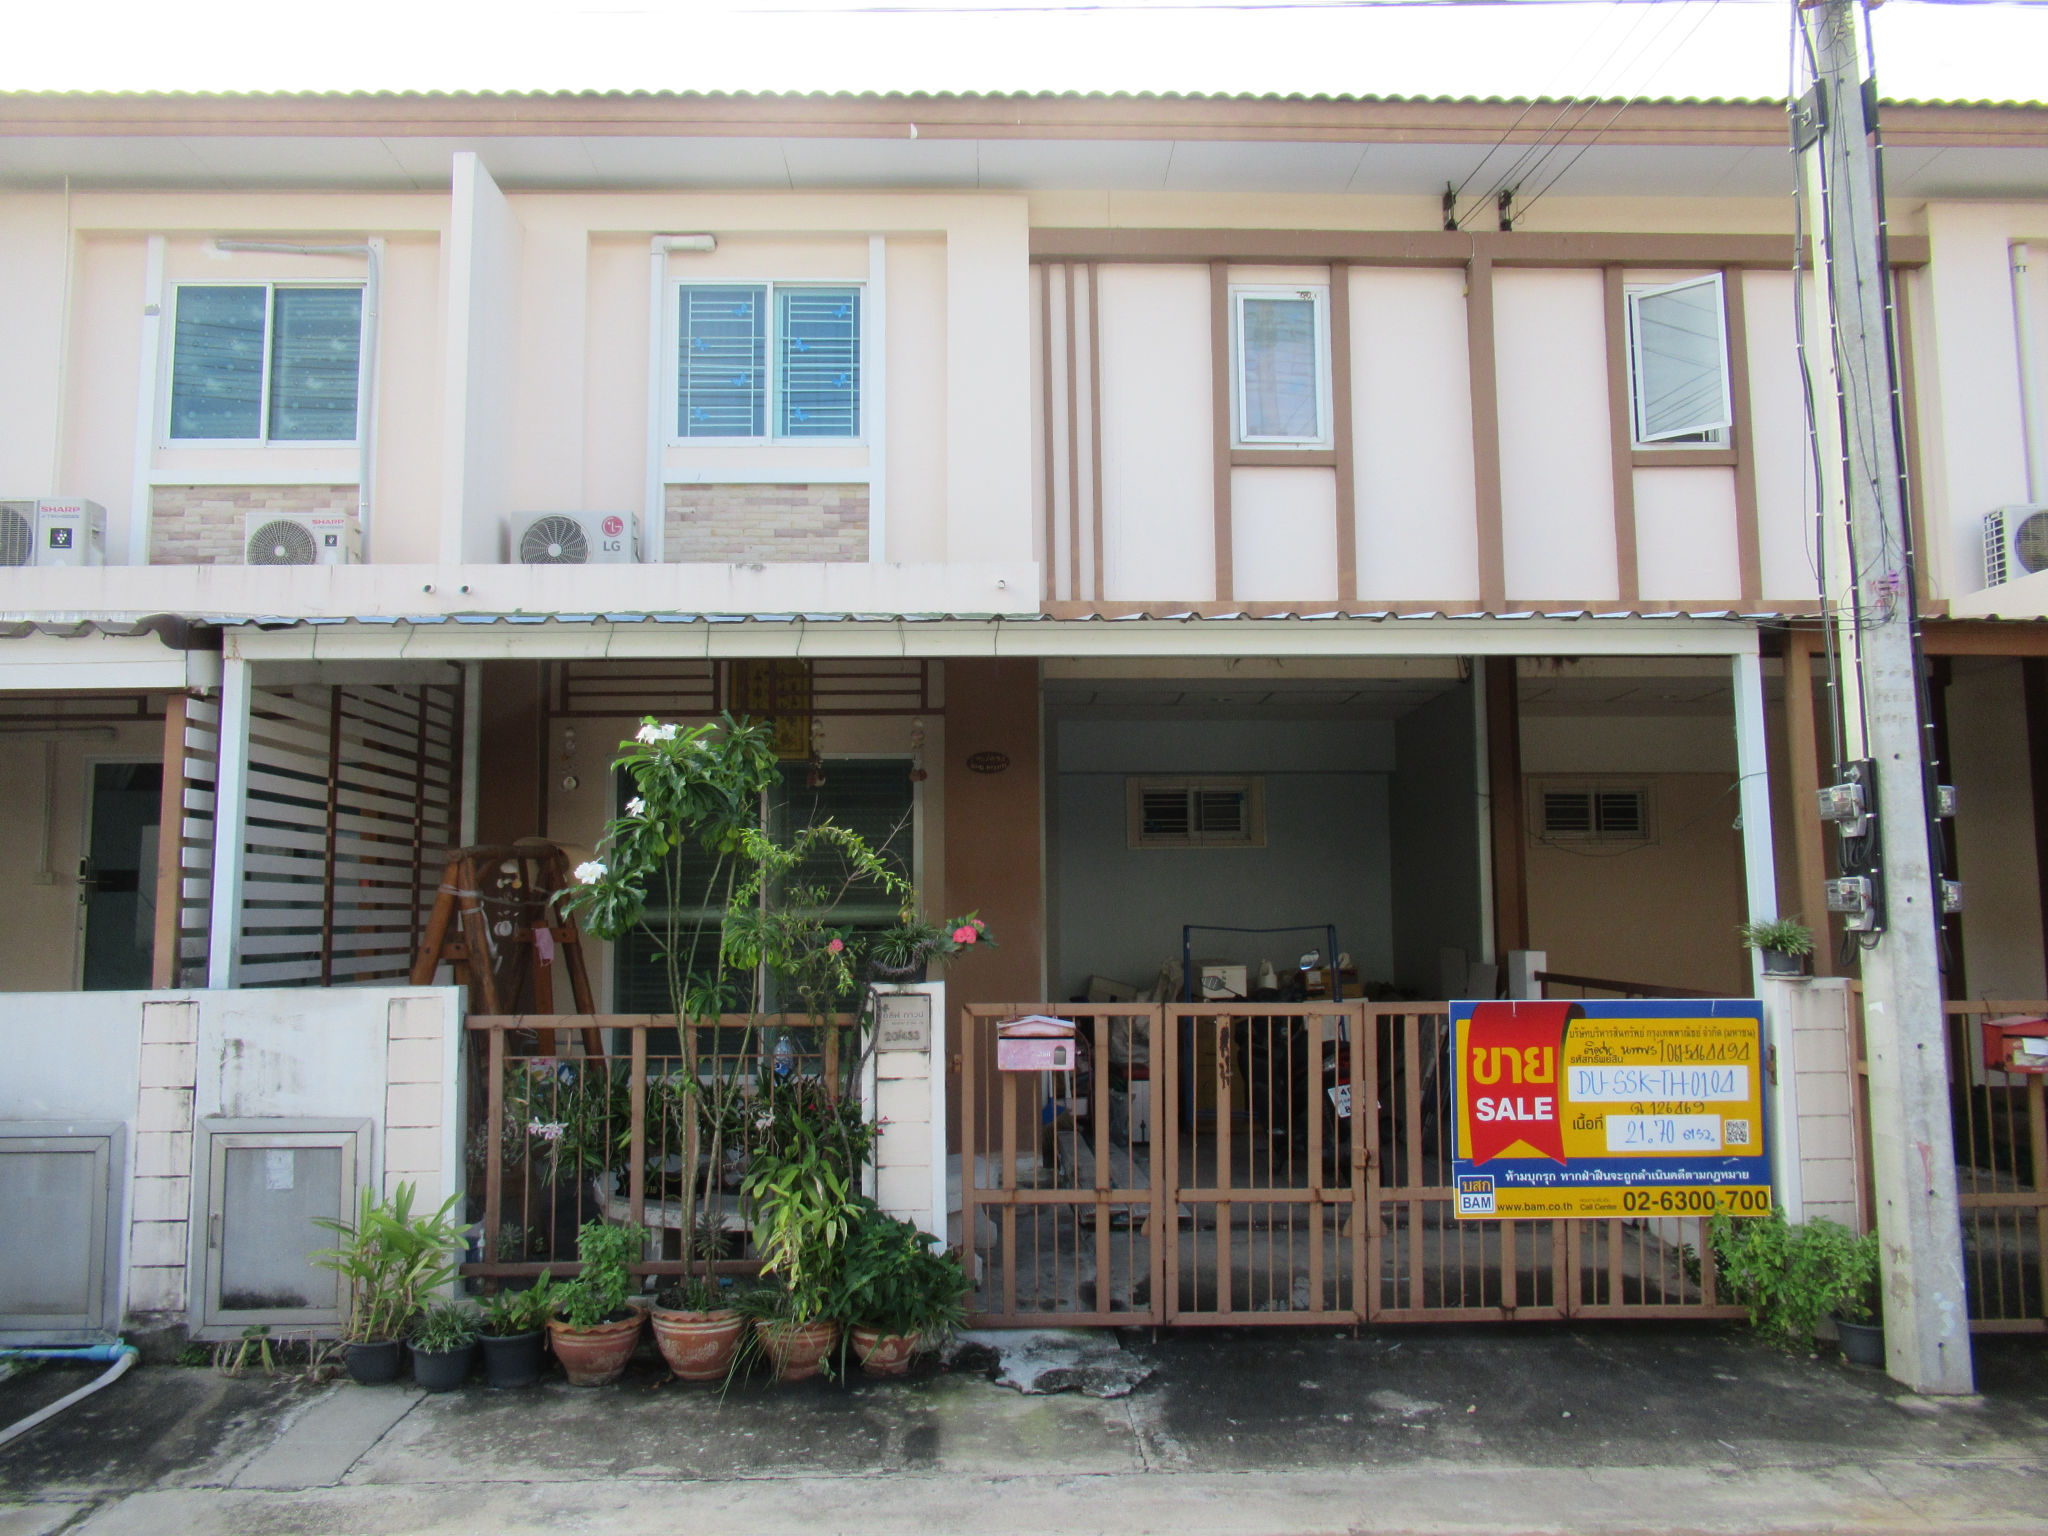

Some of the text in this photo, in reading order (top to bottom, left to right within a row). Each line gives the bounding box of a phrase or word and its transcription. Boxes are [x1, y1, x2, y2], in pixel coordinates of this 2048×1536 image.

[40, 505, 81, 513] SHARP
[603, 541, 621, 552] LG
[1472, 1046, 1554, 1085] ขาย
[1475, 1096, 1553, 1121] SALE
[1572, 1113, 1604, 1130] เนื้อที่
[1462, 1179, 1491, 1193] บสก
[1504, 1169, 1556, 1186] ห้ามบุกรุก
[1463, 1196, 1491, 1209] BAM
[1497, 1201, 1573, 1211] www.bam.co.th
[1623, 1190, 1768, 1212] 02-6300-700
